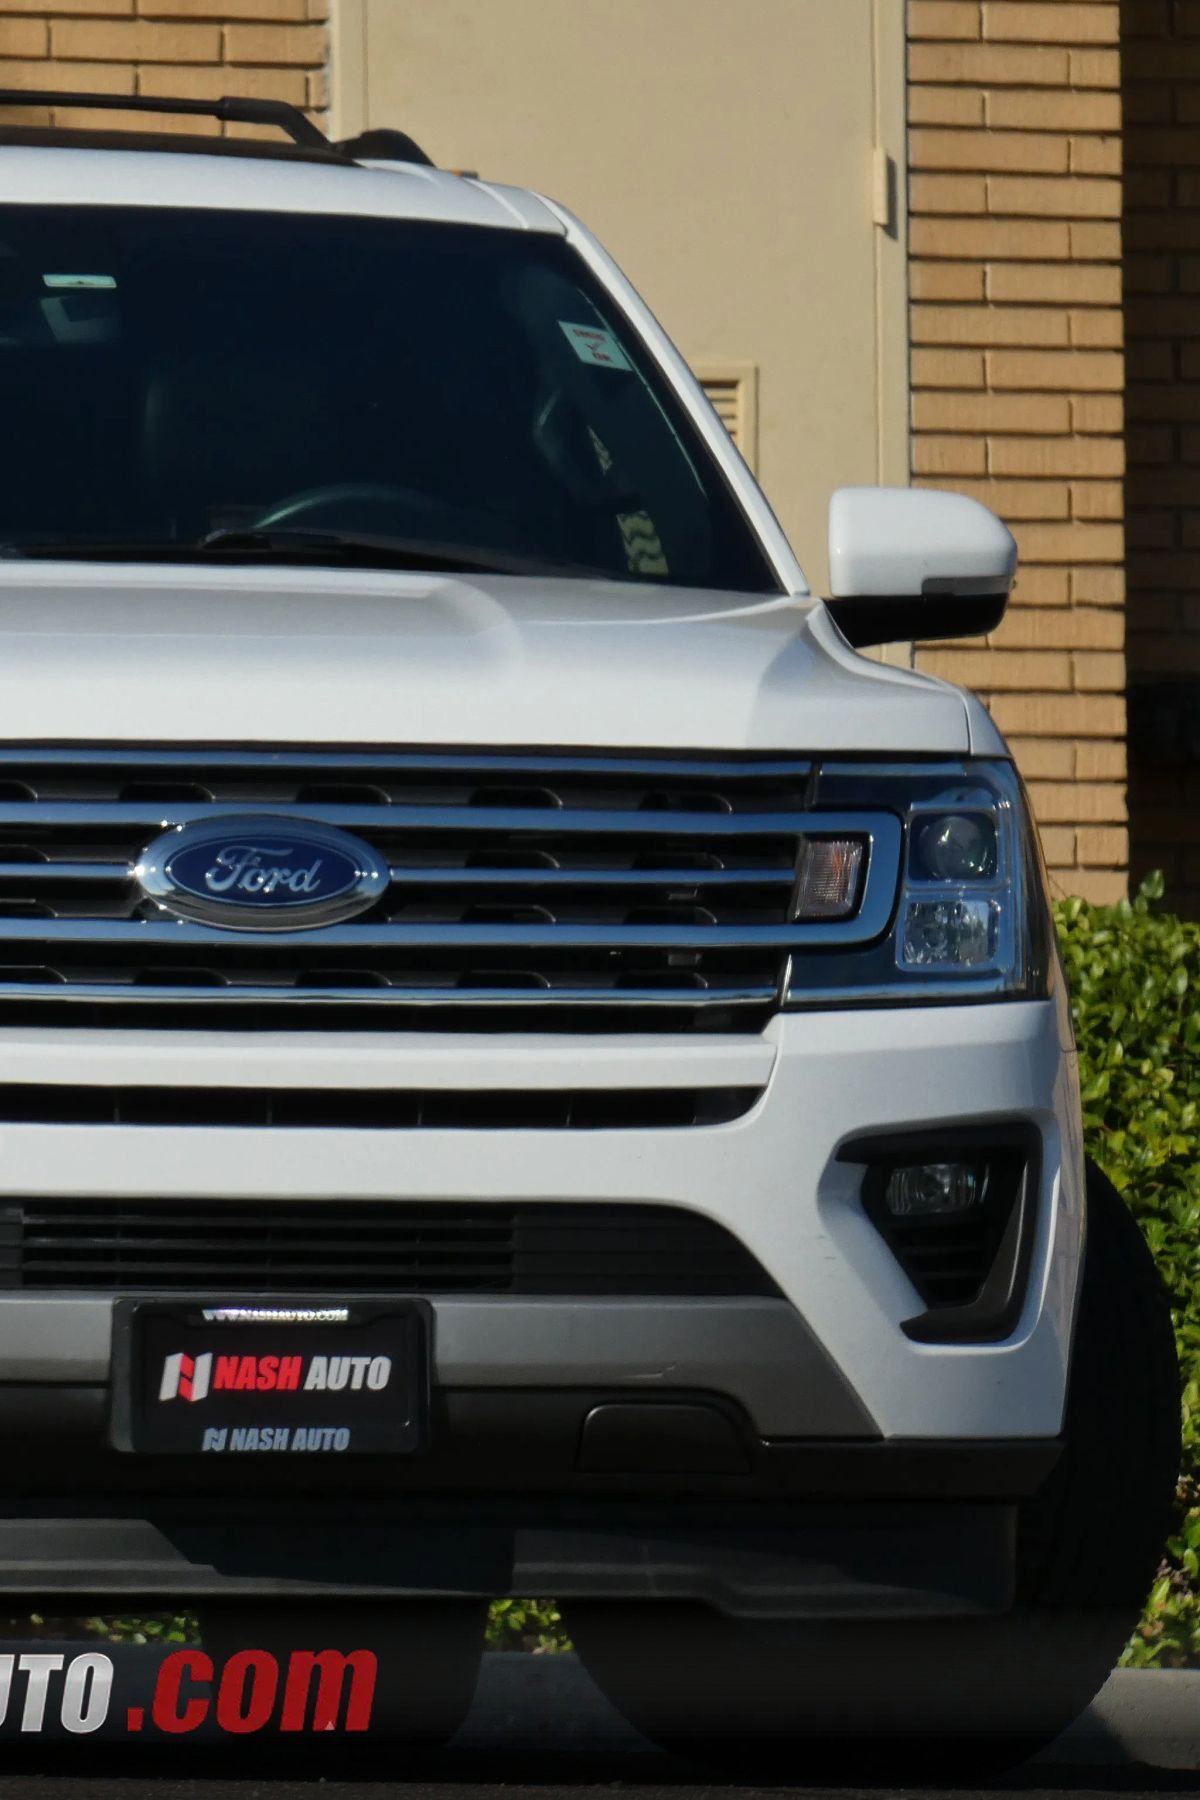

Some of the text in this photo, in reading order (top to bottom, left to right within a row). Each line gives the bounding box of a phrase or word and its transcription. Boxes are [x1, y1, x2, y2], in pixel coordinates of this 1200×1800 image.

[206, 845, 323, 893] Ford
[213, 1356, 302, 1390] NASH
[304, 1356, 392, 1390] AUTO
[229, 1428, 290, 1451] NASH
[291, 1427, 350, 1451] AUTO
